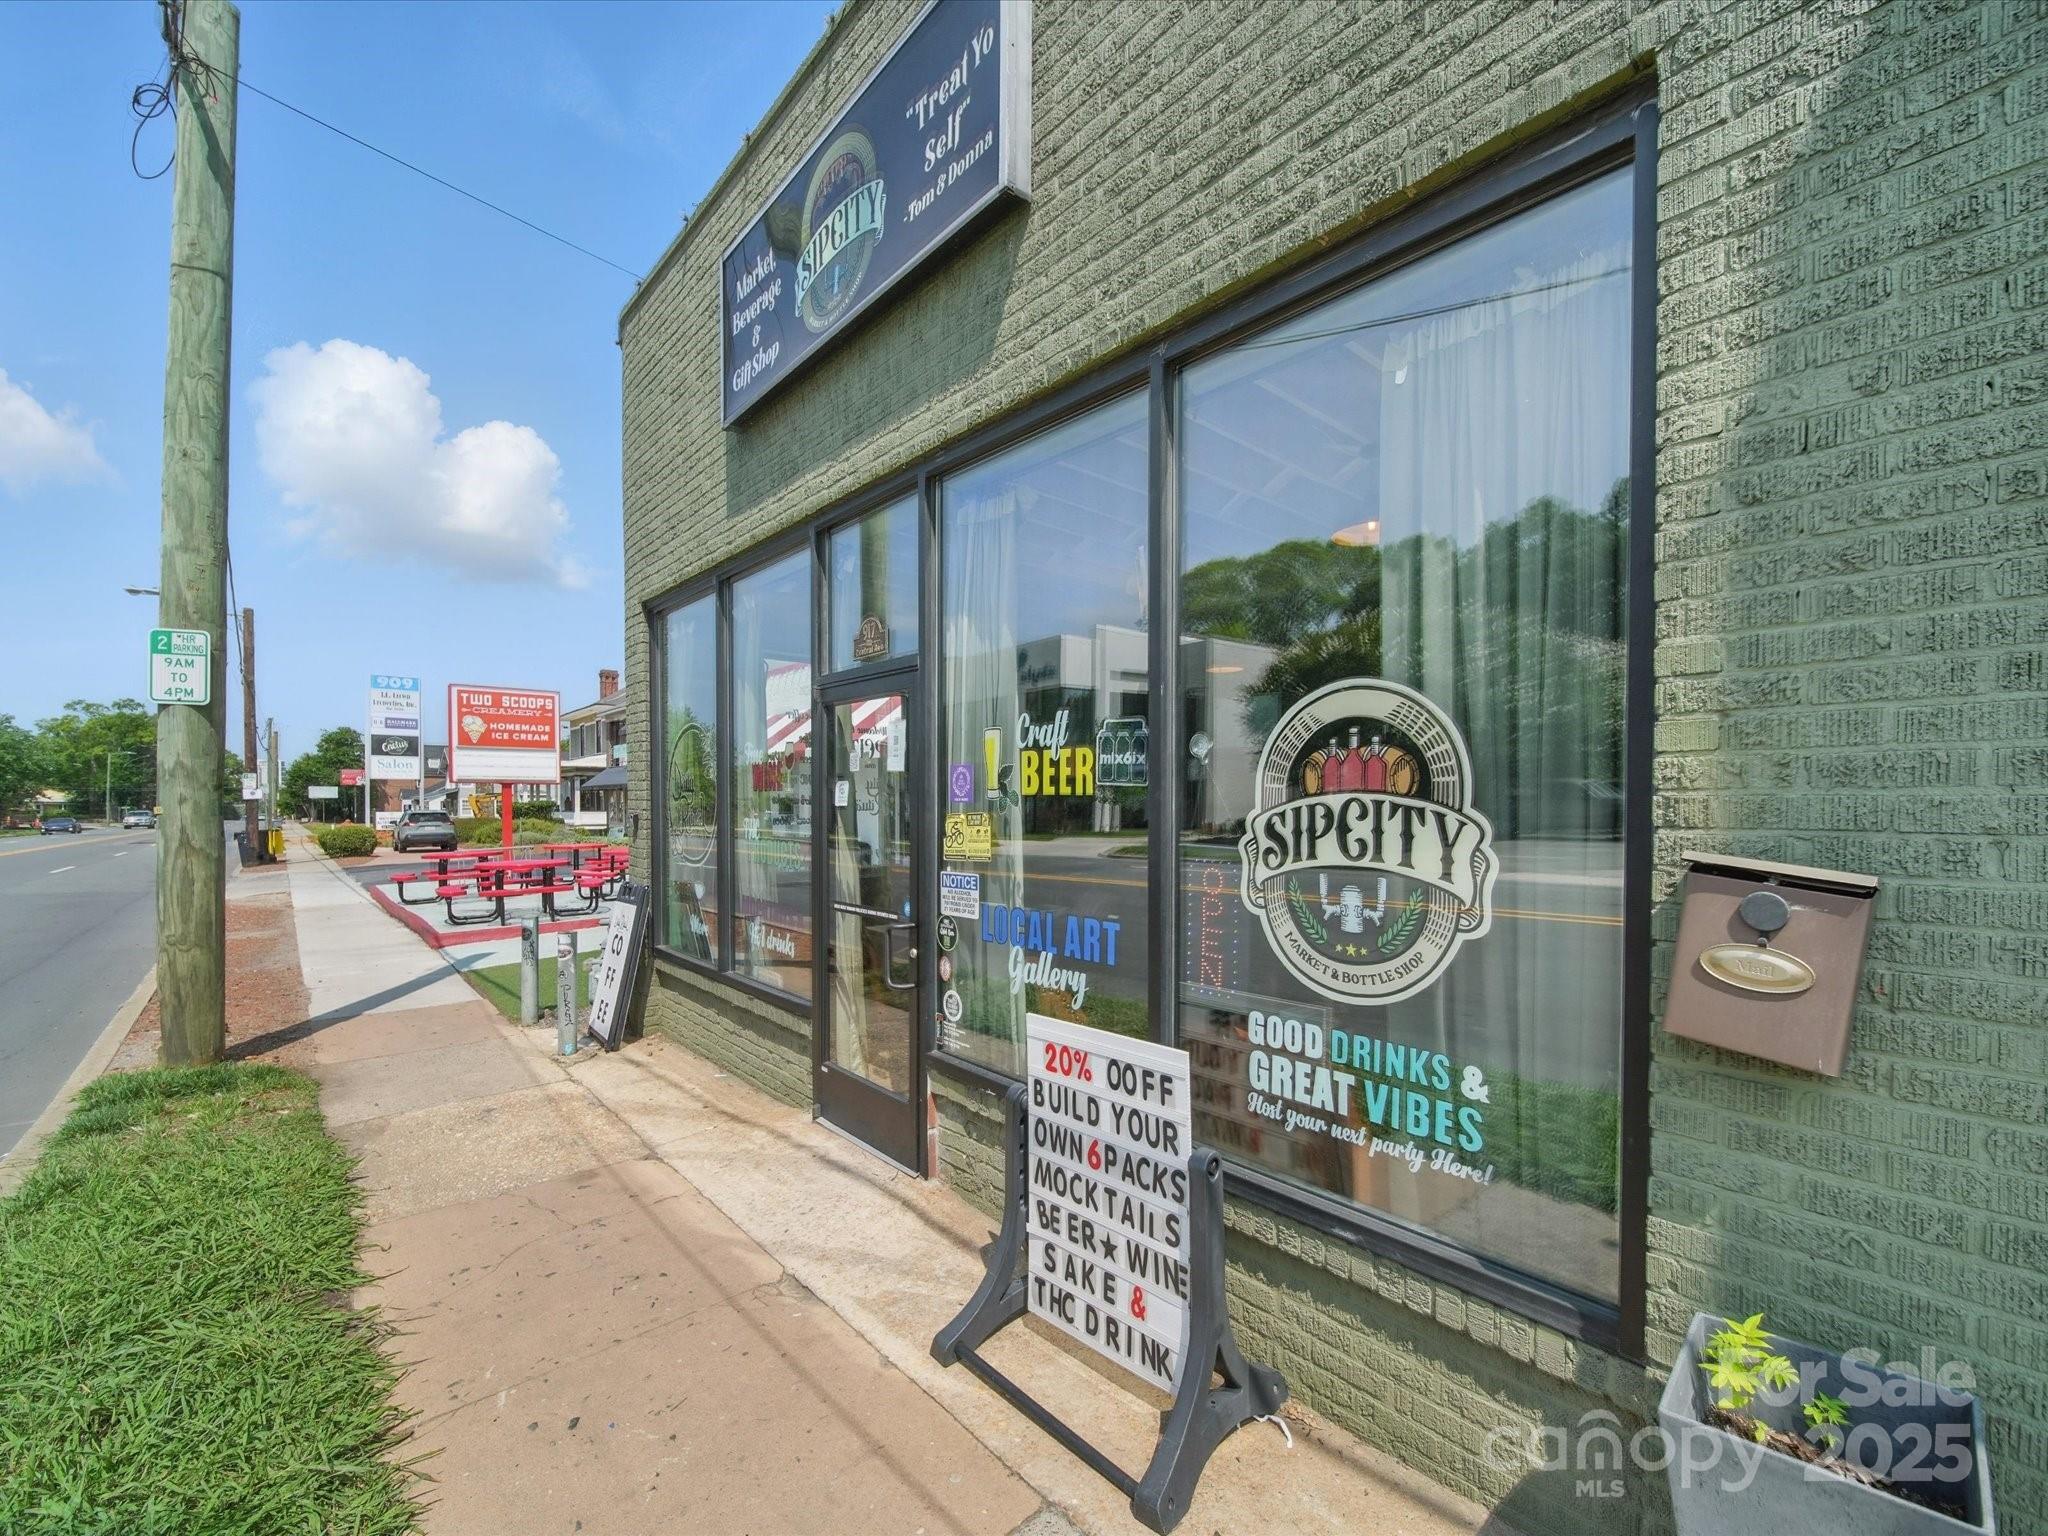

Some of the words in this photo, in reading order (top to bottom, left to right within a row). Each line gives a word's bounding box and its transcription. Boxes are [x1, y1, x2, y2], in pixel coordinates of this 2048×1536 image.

[971, 26, 994, 68] Yo
[936, 175, 947, 194] &
[948, 128, 993, 186] Donna
[801, 181, 880, 292] SIPCITY
[732, 278, 782, 337] Beverage
[752, 324, 762, 348] &
[732, 359, 752, 392] Gift
[751, 340, 780, 379] Shop
[158, 636, 168, 649] 2
[182, 635, 196, 644] HR
[173, 644, 204, 654] PARKING
[863, 622, 875, 640] 917
[170, 672, 188, 683] TO
[376, 676, 413, 689] 909
[460, 693, 492, 706] TWO
[502, 695, 553, 709] SCOOPS
[472, 706, 542, 716] CREAMERY
[490, 722, 551, 732] HOMEMADE
[1016, 710, 1069, 760] Craft
[491, 732, 509, 740] ICE
[512, 733, 549, 741] CREAM
[377, 759, 412, 769] Salon
[1021, 747, 1093, 796] BEER
[1262, 797, 1468, 884] SIPCITY
[943, 875, 976, 889] NOTICE
[981, 902, 1057, 955] LOCAL
[1064, 915, 1120, 967] ART
[1201, 867, 1222, 987] OPEN
[1008, 946, 1089, 1010] Gallery
[1284, 931, 1330, 977] MARKET
[1331, 968, 1340, 981] &
[1735, 959, 1774, 977] Mail
[1044, 1042, 1092, 1083] 20%
[1247, 1010, 1323, 1058] GOOD
[1330, 1029, 1450, 1092] DRINKS
[1460, 1065, 1490, 1104] &
[1033, 1078, 1100, 1127] BUILD
[1111, 1102, 1179, 1157] YOUR
[1248, 1049, 1355, 1117] GREAT
[1364, 1079, 1484, 1153] VIBES
[1247, 1091, 1284, 1121] Host
[1286, 1107, 1328, 1132] your
[1330, 1123, 1367, 1148] next
[1369, 1136, 1427, 1173] party
[1034, 1157, 1180, 1248] MOCKTAILS
[1036, 1199, 1097, 1254] BEER
[1127, 1238, 1188, 1301] WINE
[1044, 1241, 1116, 1306] SAKE
[1130, 1285, 1146, 1321] &
[1034, 1276, 1075, 1325] THC
[1086, 1306, 1173, 1382] DRINK
